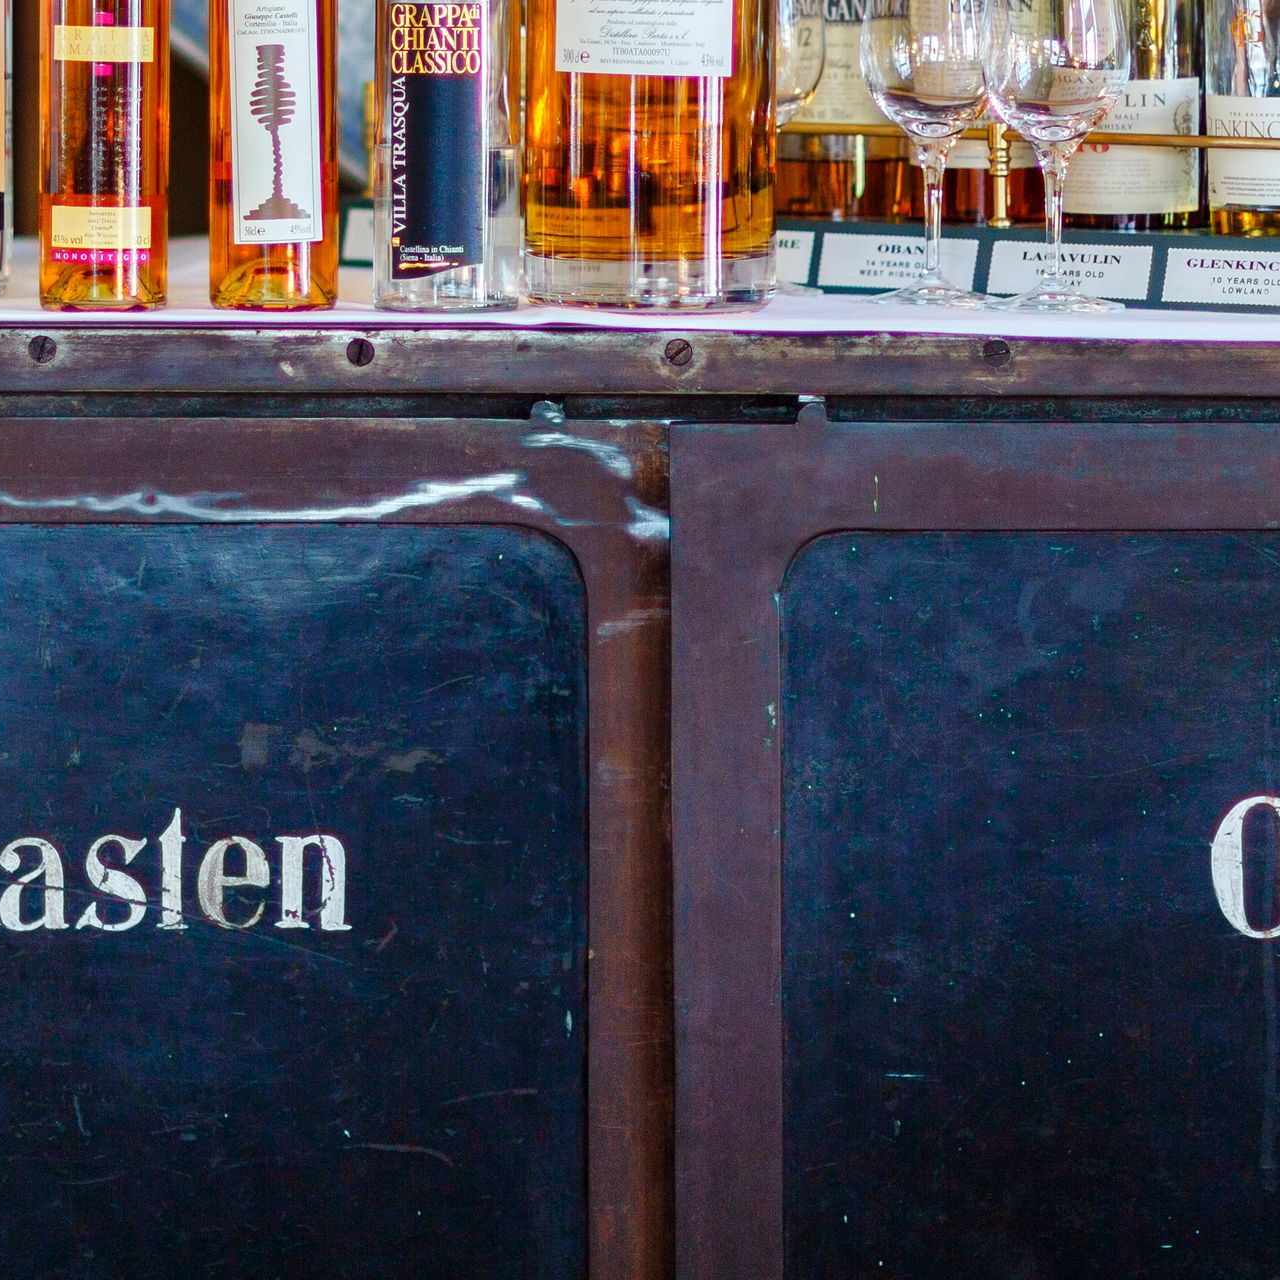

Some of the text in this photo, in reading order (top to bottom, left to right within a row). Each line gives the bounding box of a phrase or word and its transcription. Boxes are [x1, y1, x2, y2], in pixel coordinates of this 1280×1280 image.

[244, 13, 272, 21] Giuseppe
[392, 4, 480, 27] GRAPPA di
[392, 27, 480, 50] CHIANTI
[562, 49, 574, 63] 300
[612, 47, 670, 57] IT00ATA00097U
[392, 50, 480, 74] CLASSICO
[392, 75, 409, 234] VILLA TRASQUA
[53, 236, 83, 245] 41% vol
[400, 245, 464, 253] Castellina in Chianti
[877, 243, 925, 255] OBAN
[400, 253, 444, 262] (Siena Italia)
[881, 261, 910, 269] YEARS
[888, 271, 925, 279] HIGHLA
[1085, 271, 1104, 279] OLD
[1227, 277, 1259, 285] YEARS
[1222, 287, 1269, 295] LOWLAND
